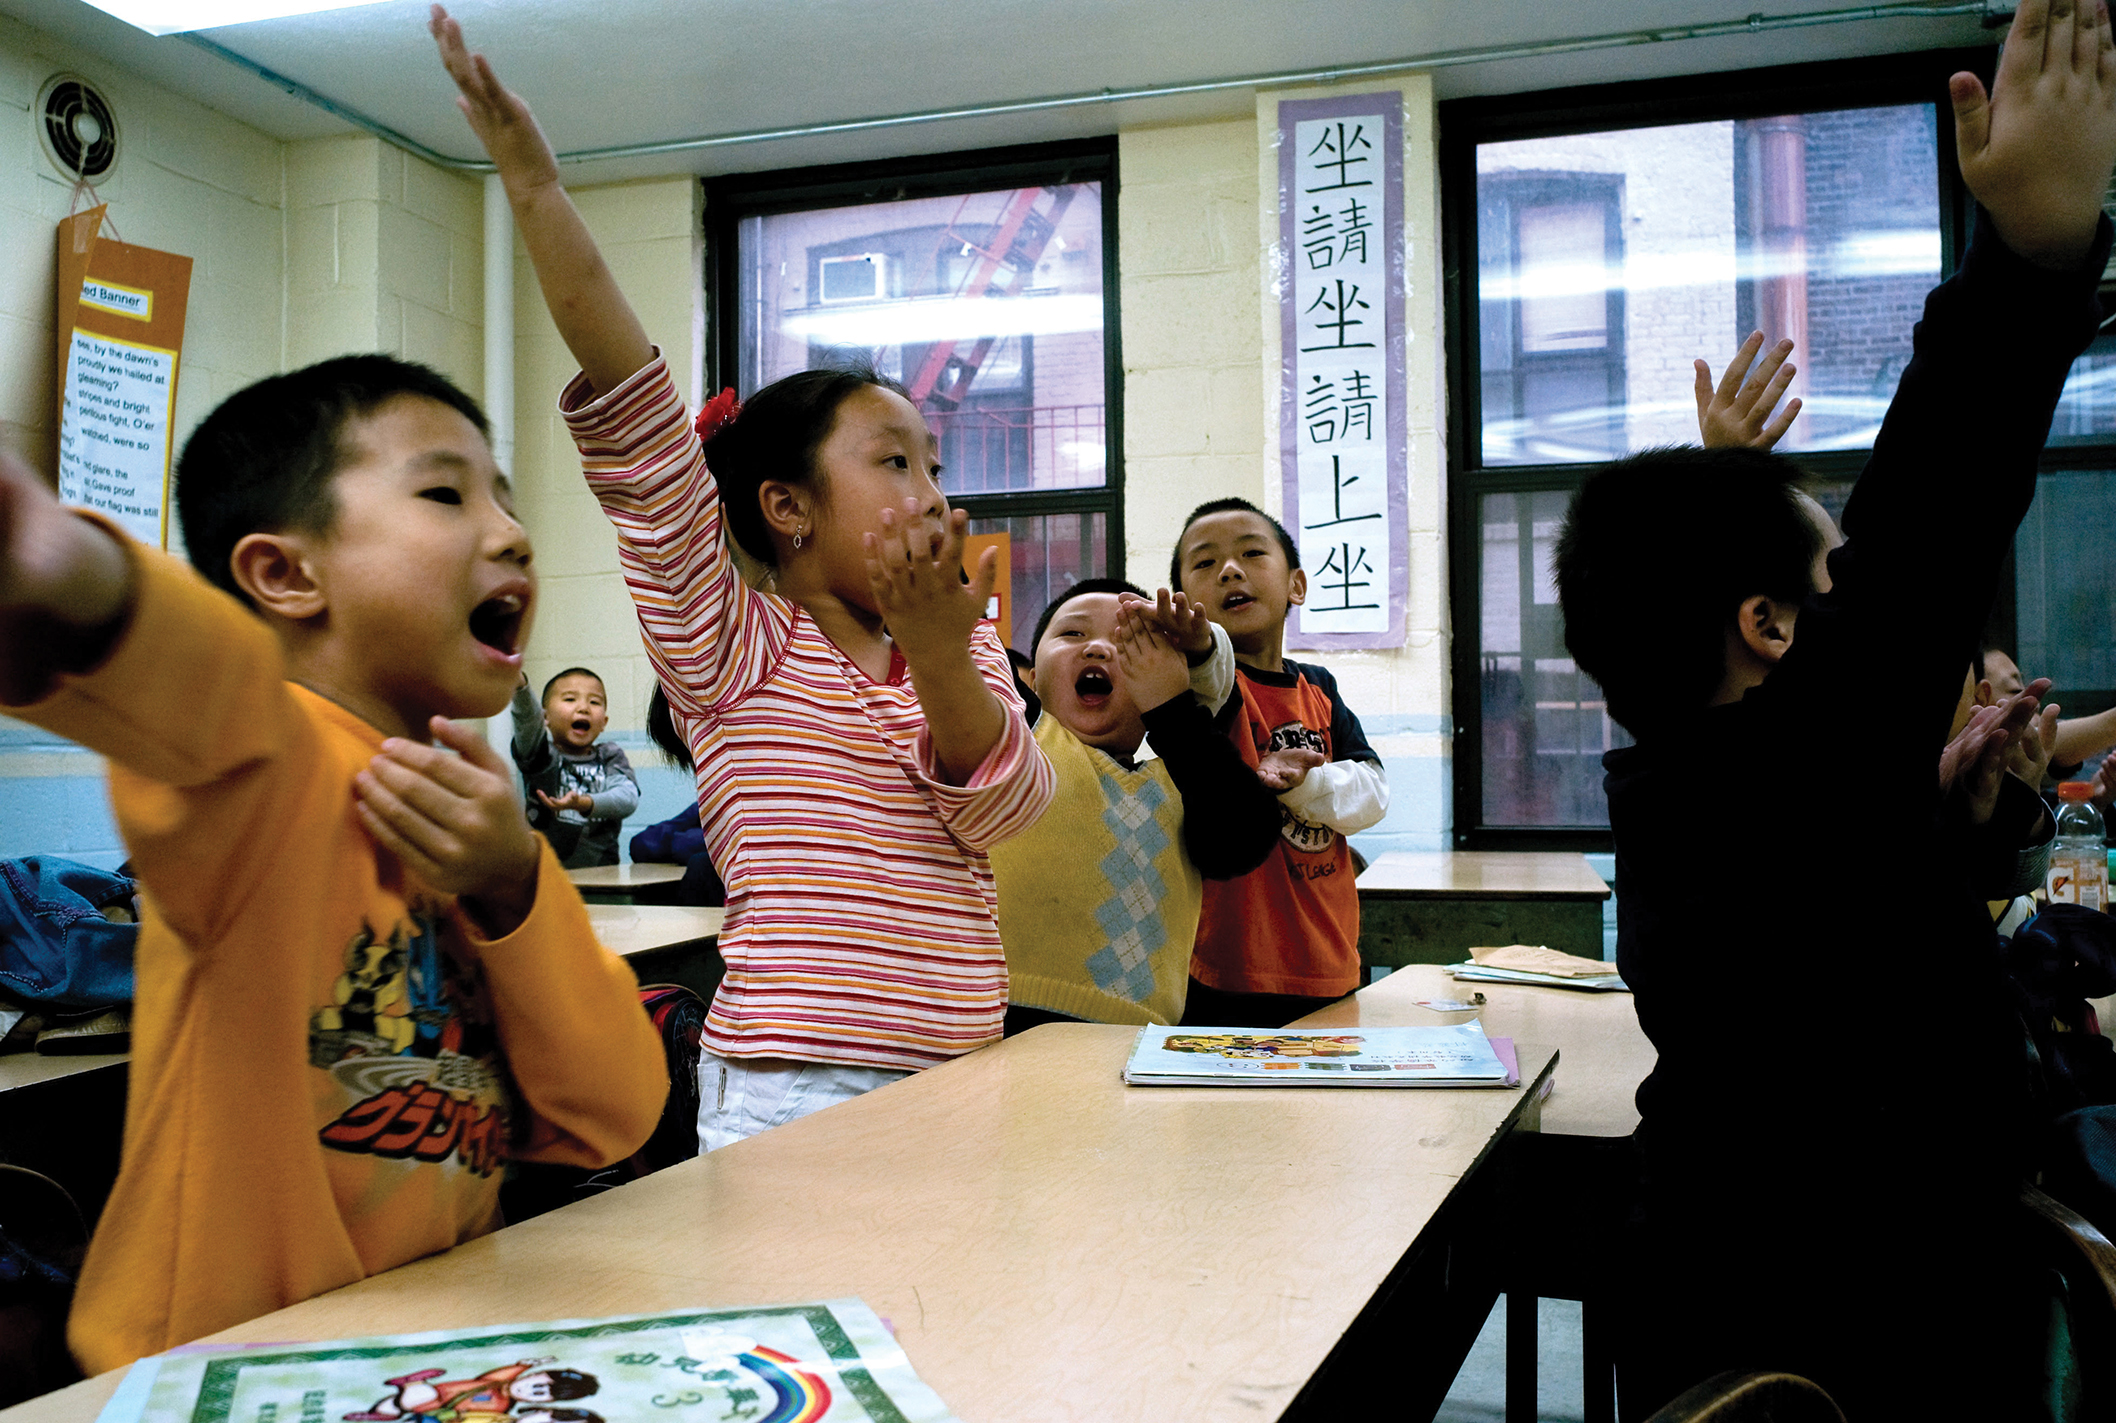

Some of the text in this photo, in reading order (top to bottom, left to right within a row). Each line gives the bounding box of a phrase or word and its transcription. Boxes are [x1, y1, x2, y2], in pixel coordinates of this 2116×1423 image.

[99, 287, 141, 307] Banner
[94, 343, 107, 357] by
[108, 346, 122, 360] the
[124, 351, 159, 368] dawn's
[107, 364, 123, 376] we
[124, 366, 153, 383] hailed
[154, 375, 165, 385] at
[1300, 122, 1382, 613] 坐請坐請上坐
[77, 372, 120, 392] gleaming?
[103, 396, 120, 409] and
[122, 399, 151, 415] bright
[132, 417, 155, 431] O'er
[112, 436, 135, 449] were
[136, 441, 150, 452] so
[114, 468, 129, 480] the
[113, 486, 136, 498] proof
[94, 498, 107, 508] our
[107, 499, 123, 514] flag
[124, 504, 141, 516] was
[143, 507, 159, 518] still
